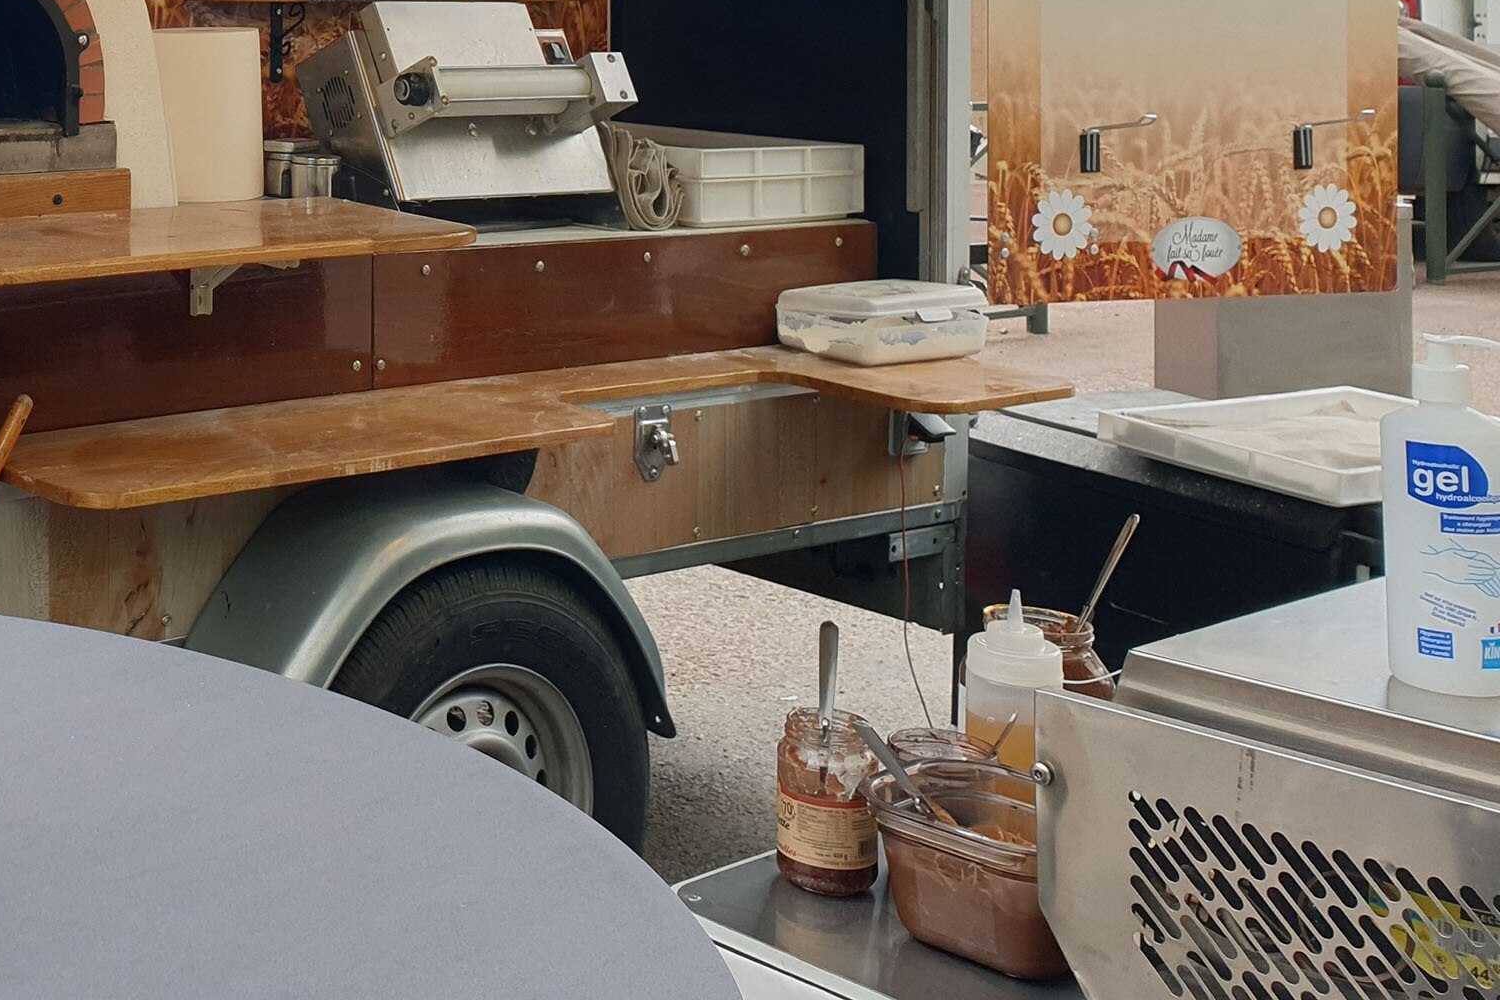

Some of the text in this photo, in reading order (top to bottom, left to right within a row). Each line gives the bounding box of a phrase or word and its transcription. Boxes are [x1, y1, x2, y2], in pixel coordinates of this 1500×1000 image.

[1172, 222, 1219, 249] Madame
[1166, 244, 1182, 263] fait
[1412, 465, 1470, 497] gel
